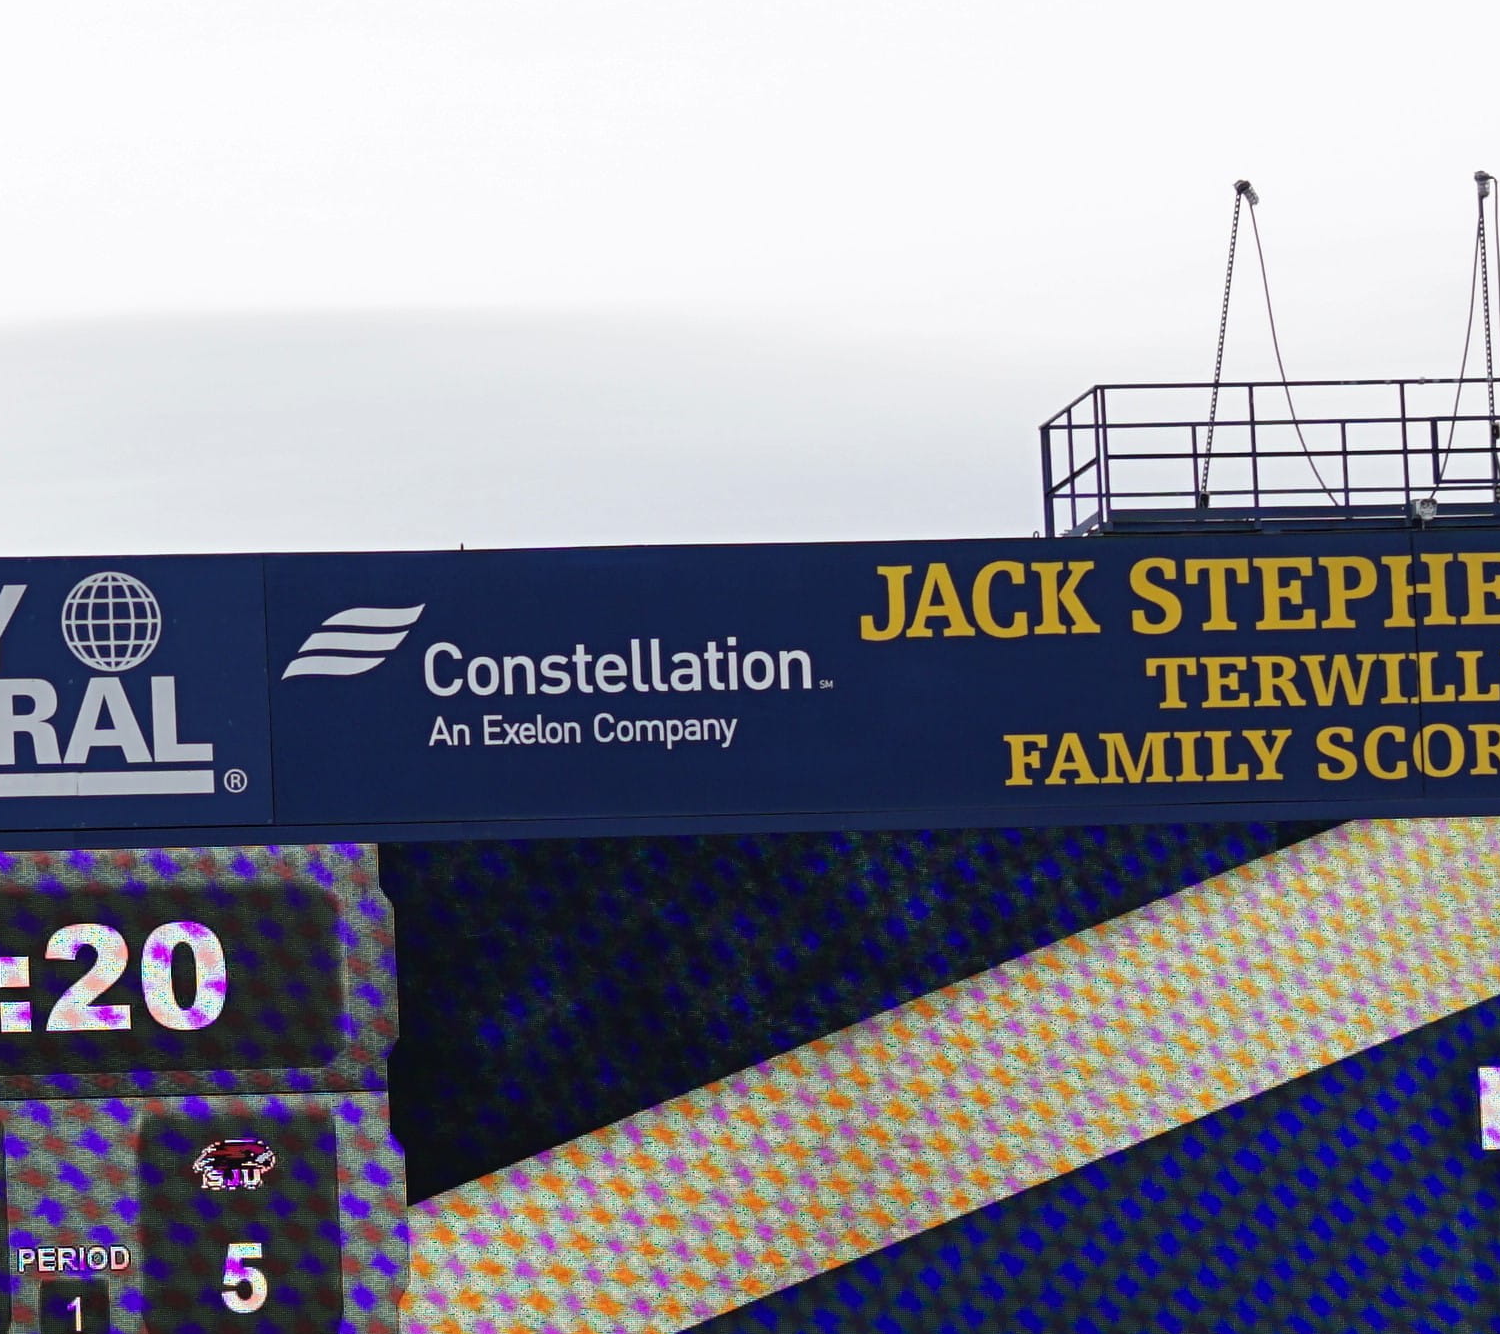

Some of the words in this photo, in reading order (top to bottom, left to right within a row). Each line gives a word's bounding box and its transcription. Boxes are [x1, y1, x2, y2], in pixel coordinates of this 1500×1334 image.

[860, 560, 1101, 641] JACK
[423, 636, 812, 696] Constellation
[429, 715, 470, 746] An
[482, 714, 581, 746] Exelon
[593, 713, 738, 750] Company
[1003, 728, 1293, 786] FAMILY
[17, 1246, 132, 1273] PERIOD
[221, 1242, 268, 1313] 5
[67, 1296, 83, 1332] 1
